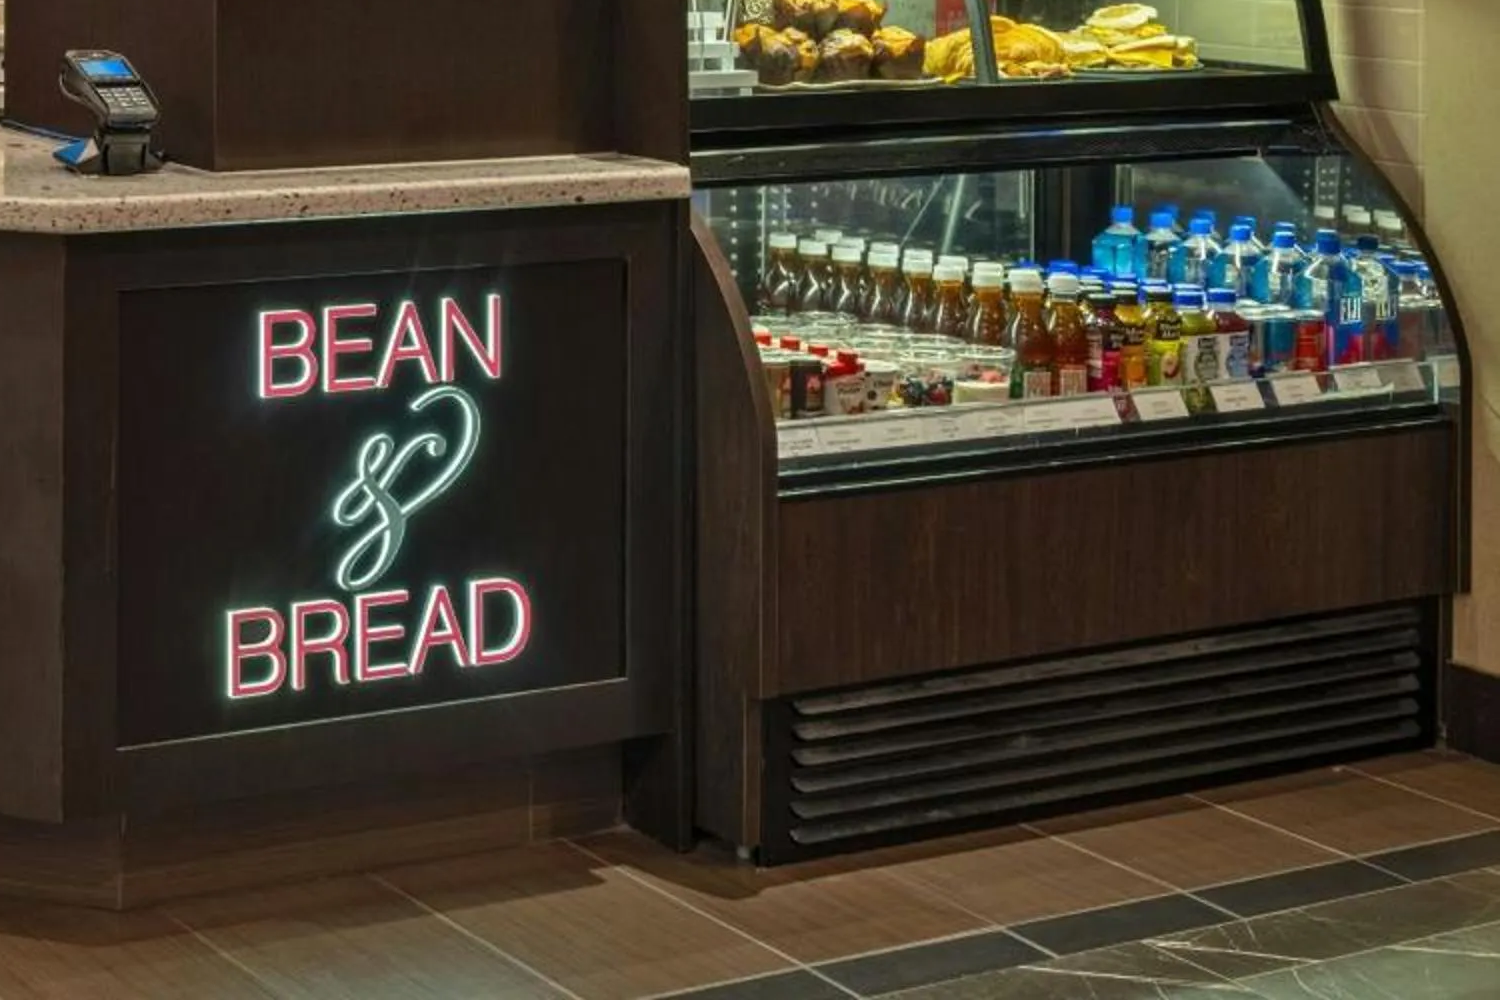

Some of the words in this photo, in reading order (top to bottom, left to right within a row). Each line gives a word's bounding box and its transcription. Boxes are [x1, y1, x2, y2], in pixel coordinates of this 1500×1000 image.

[259, 293, 501, 399] BEAN
[333, 386, 481, 590] &
[227, 577, 532, 698] BREAD
